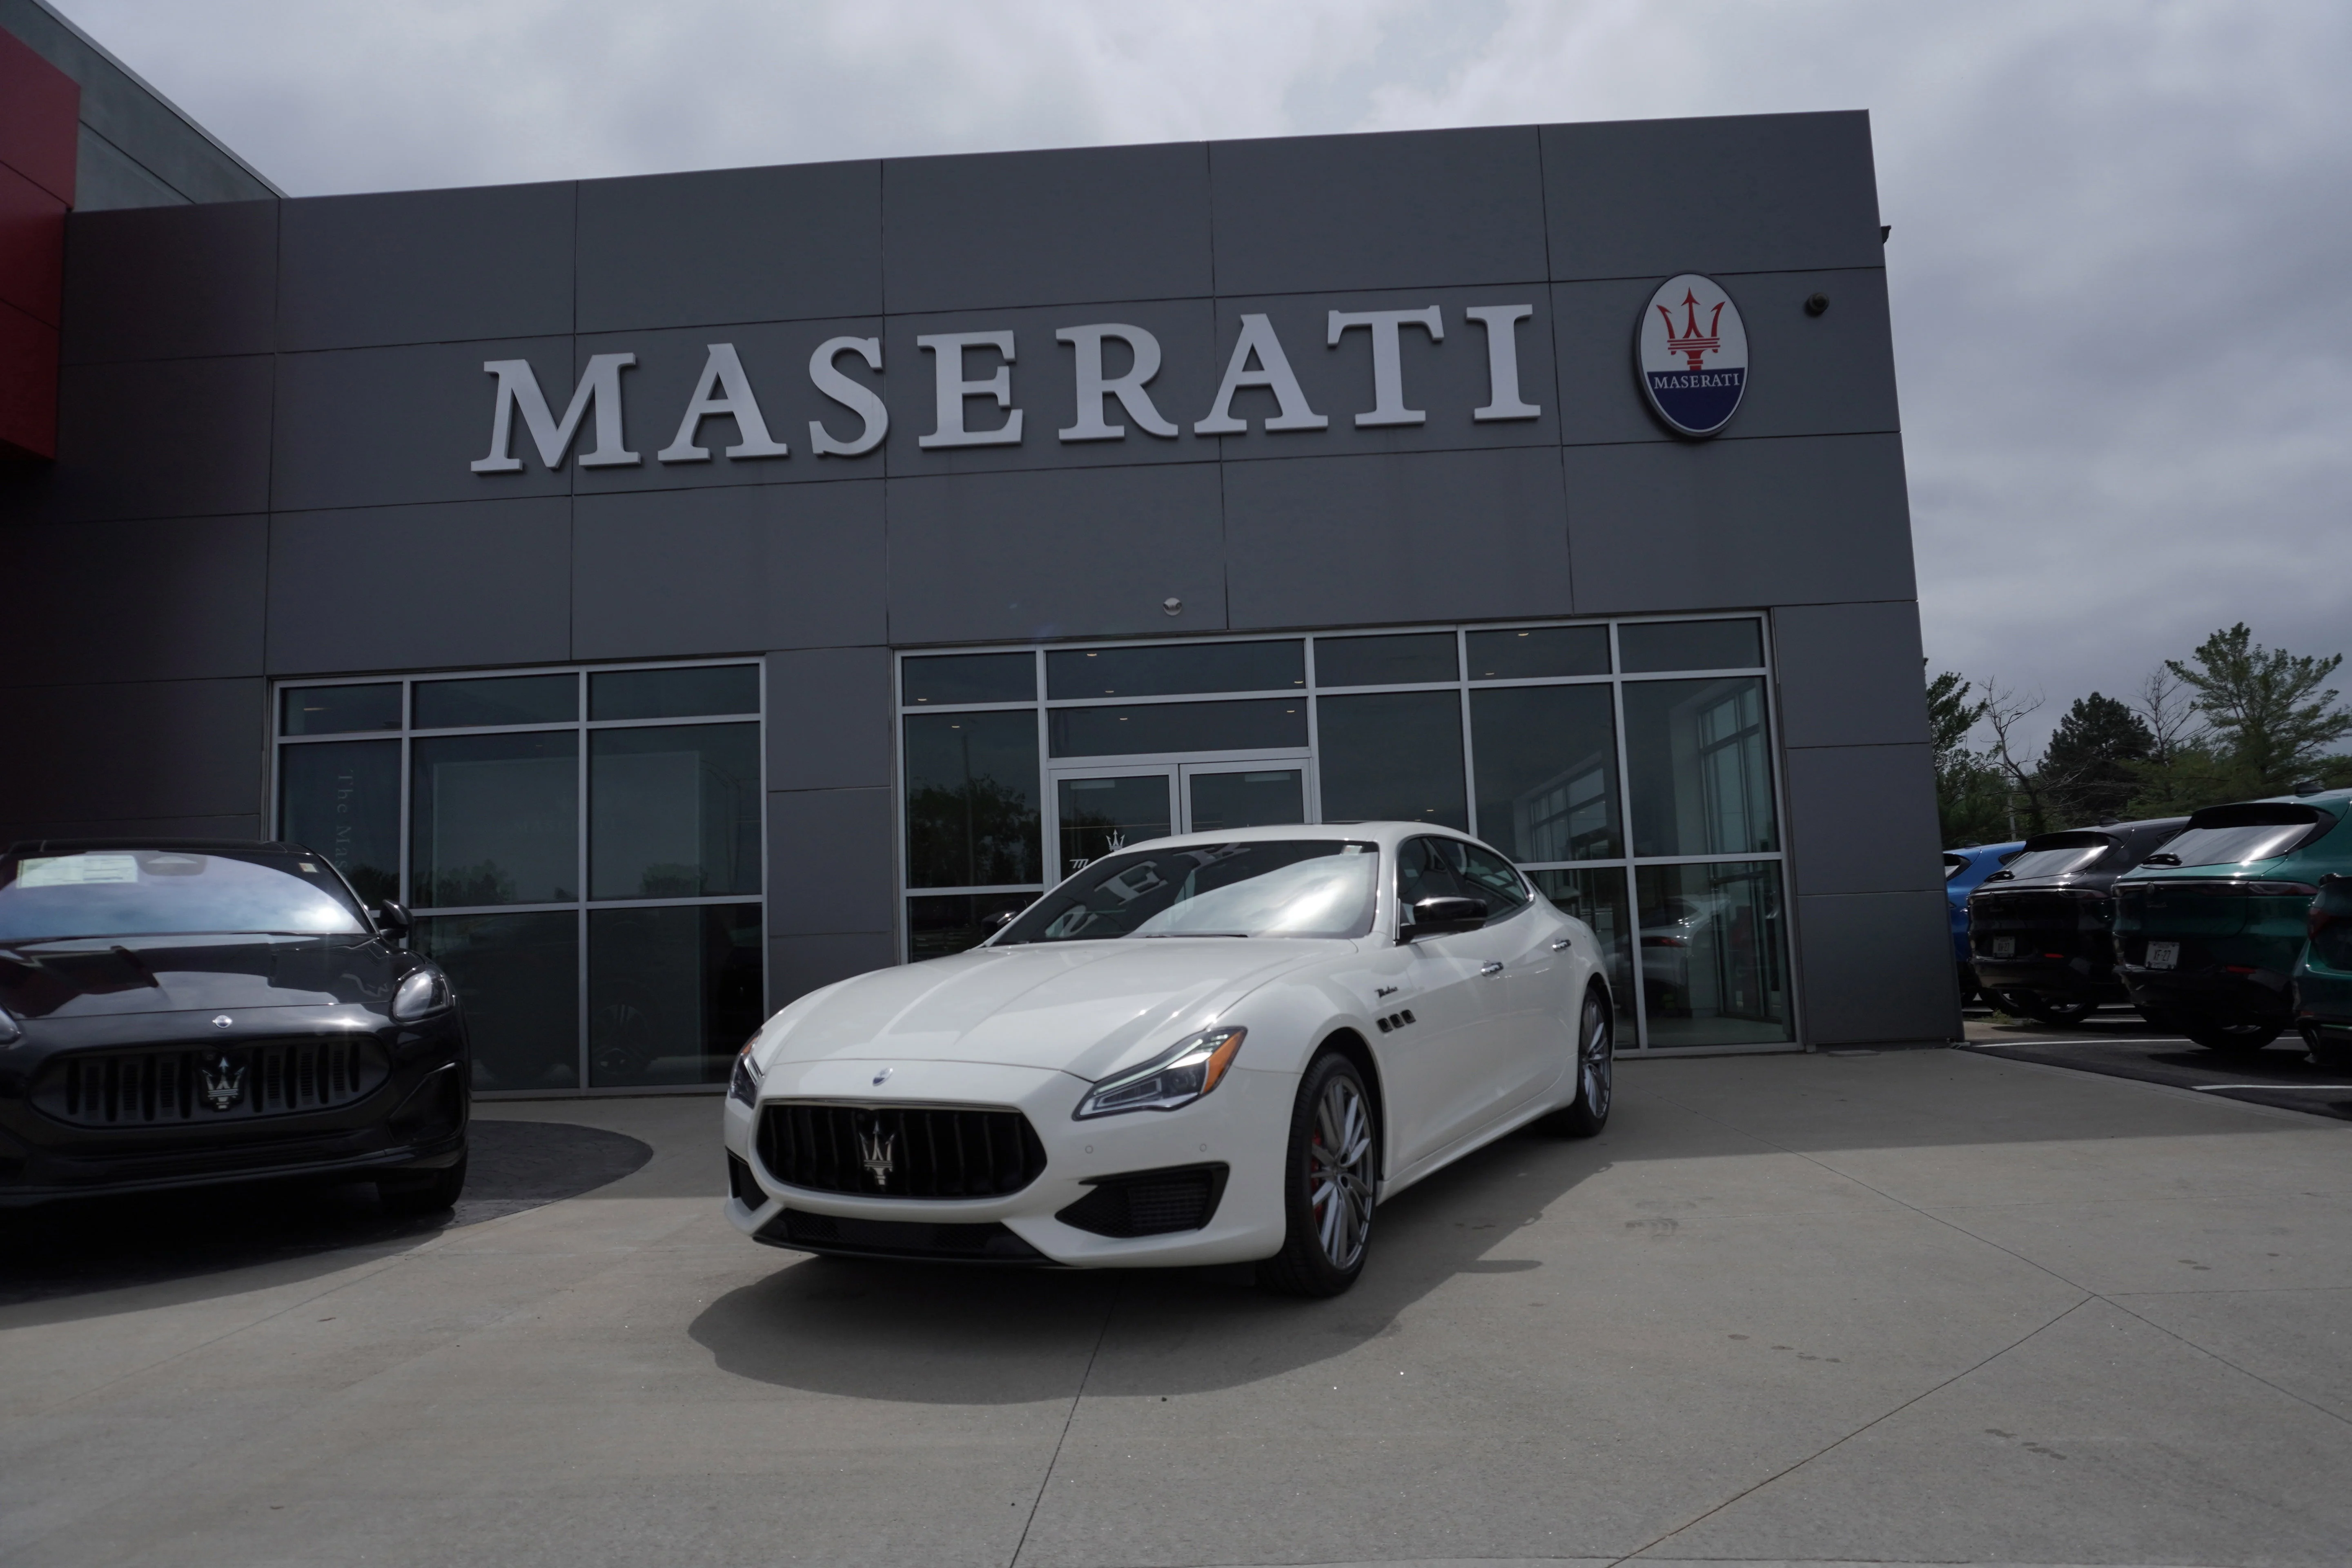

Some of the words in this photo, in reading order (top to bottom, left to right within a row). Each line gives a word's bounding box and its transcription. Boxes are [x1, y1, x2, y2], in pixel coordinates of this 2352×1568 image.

[470, 304, 1541, 474] MASERATI
[1654, 373, 1740, 389] MASERATI
[337, 769, 354, 813] The
[334, 825, 352, 878] Mas
